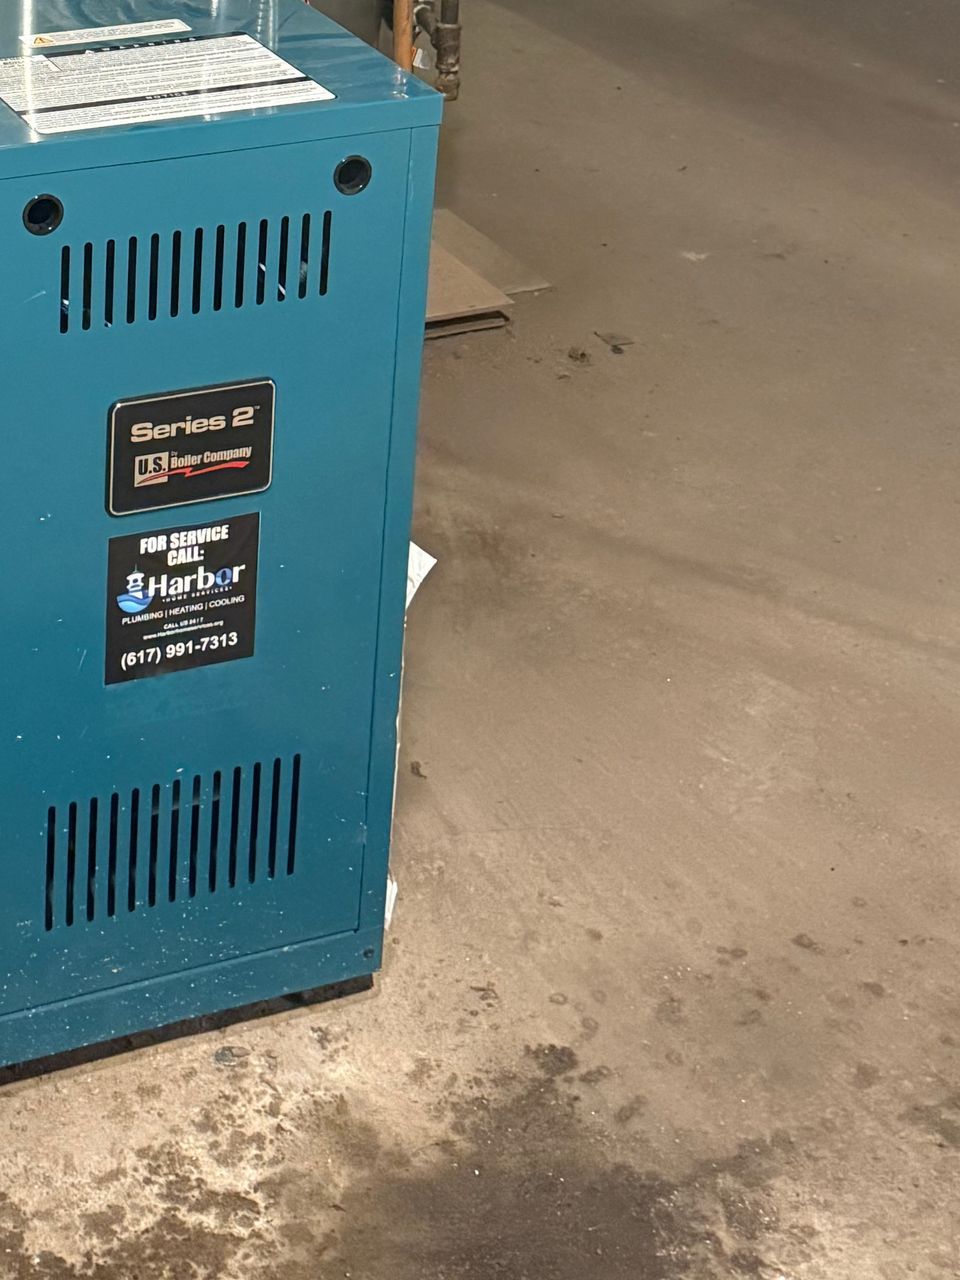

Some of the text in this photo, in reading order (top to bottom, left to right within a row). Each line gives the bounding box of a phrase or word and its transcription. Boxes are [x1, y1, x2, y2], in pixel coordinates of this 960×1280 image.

[130, 415, 226, 443] Series
[138, 446, 253, 476] U.S. Boiler Company
[140, 524, 230, 555] FOR SERVICE
[166, 545, 205, 567] CALL:
[147, 563, 246, 597] Harbor
[121, 610, 164, 625] PLUMBING
[169, 602, 204, 616] HEATING
[209, 594, 245, 609] COOLING
[120, 631, 238, 671] (617) 991-7313
